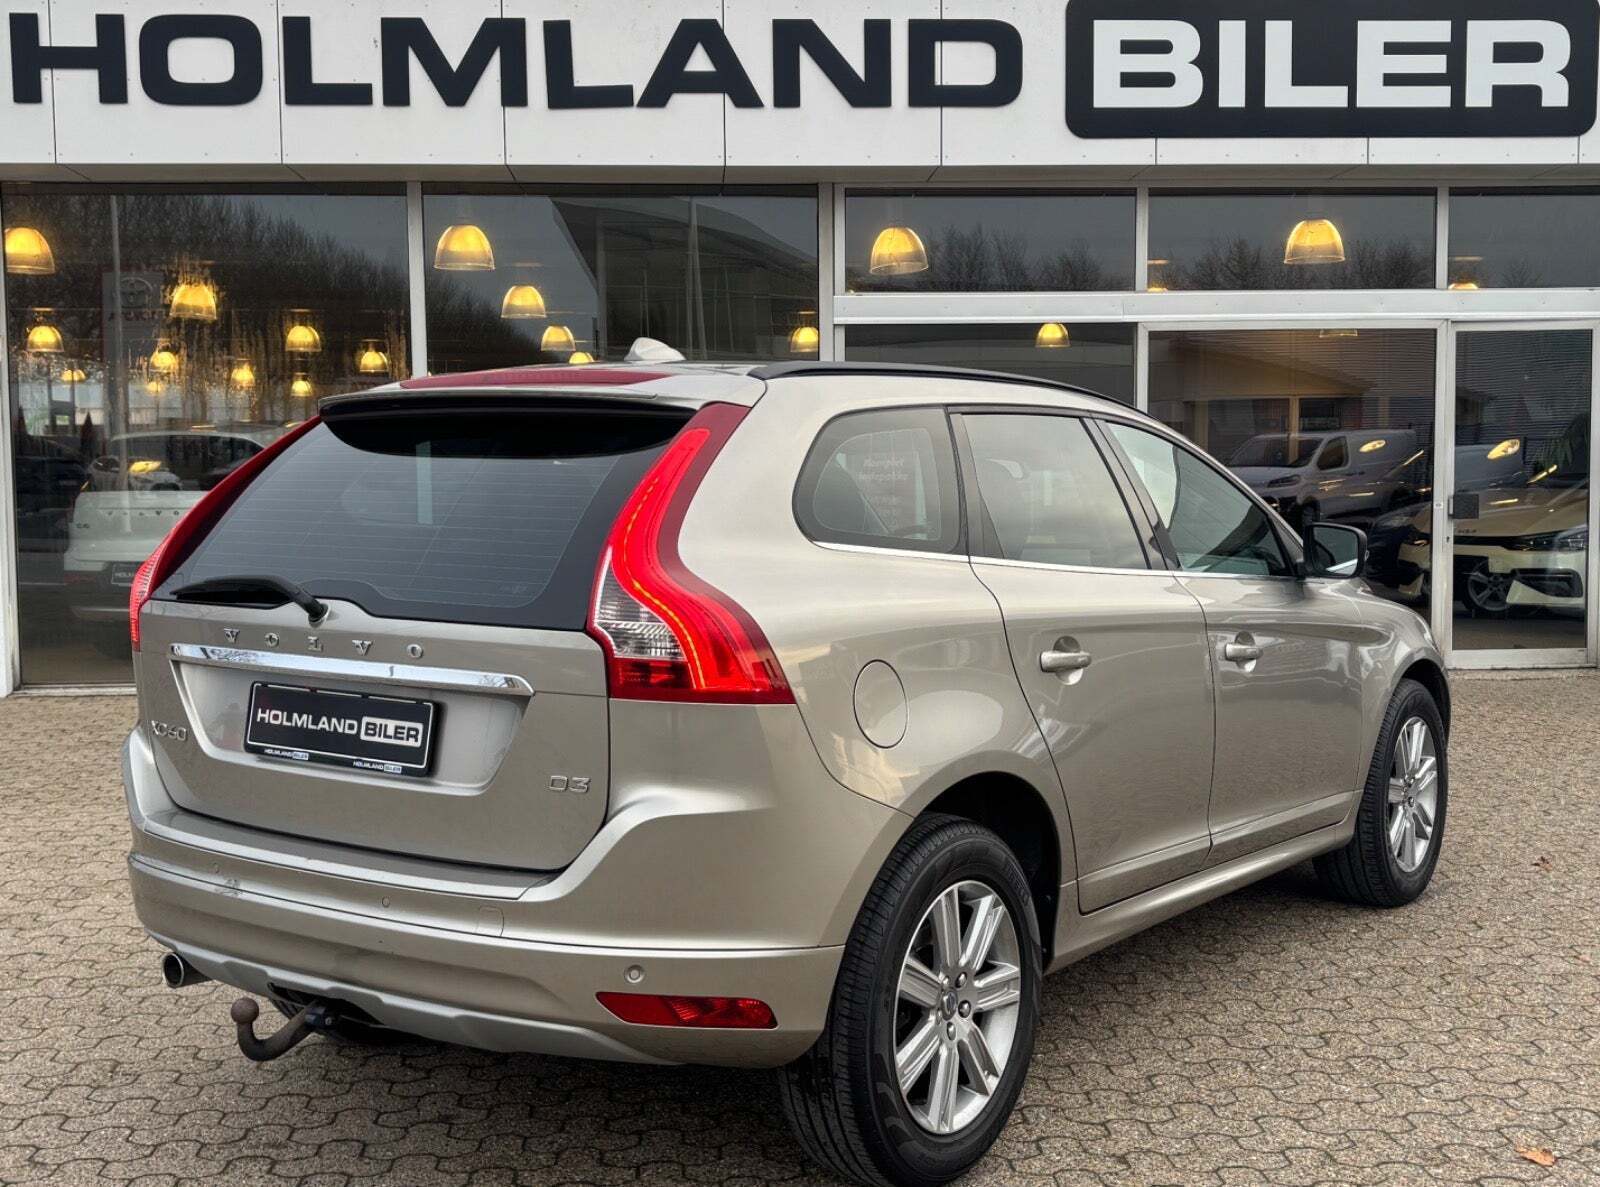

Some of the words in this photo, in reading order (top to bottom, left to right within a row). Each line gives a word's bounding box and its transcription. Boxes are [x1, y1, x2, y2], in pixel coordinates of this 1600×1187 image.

[8, 12, 1023, 108] HOLMLAND
[1092, 19, 1571, 108] BILER
[223, 627, 425, 660] VOLVO
[151, 719, 188, 741] XC60
[256, 708, 358, 735] HOLMLAND
[363, 721, 420, 743] BILER
[264, 748, 293, 758] HOLMLAND
[353, 760, 384, 770] HOLMLAND
[549, 775, 591, 793] D3
